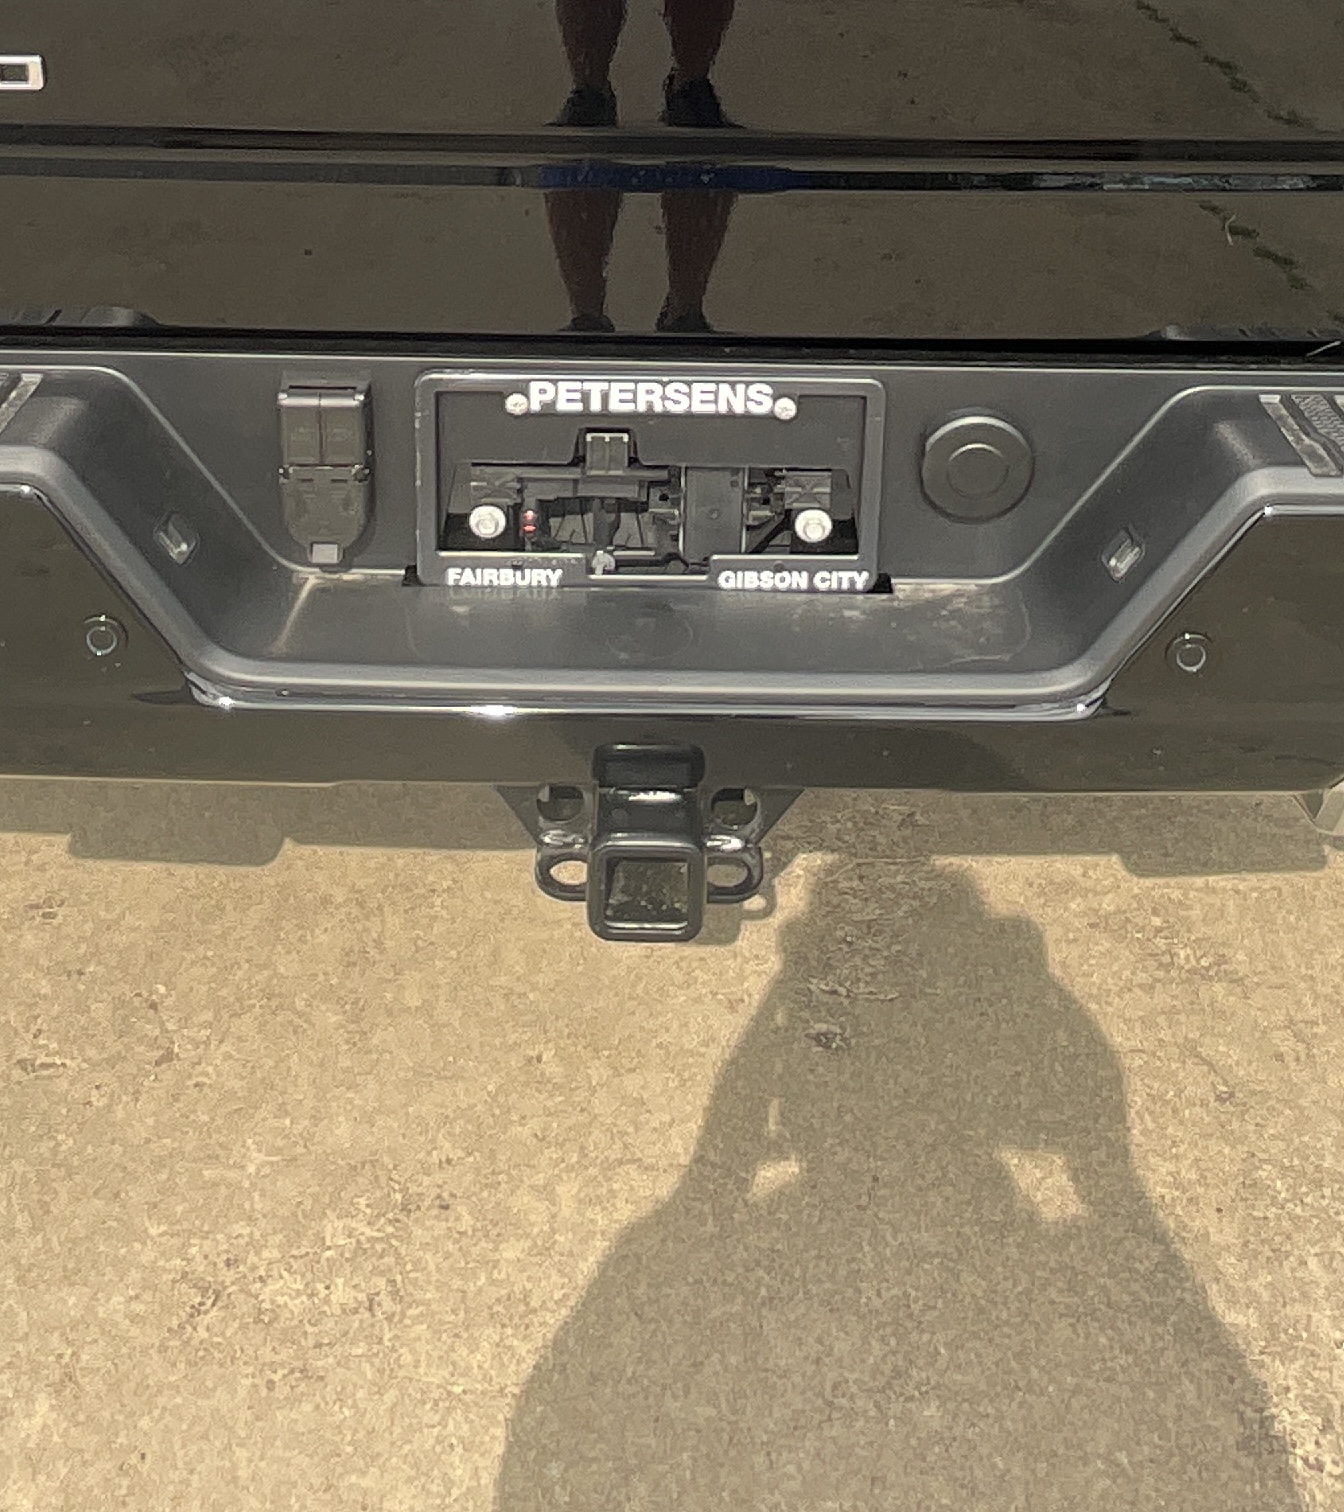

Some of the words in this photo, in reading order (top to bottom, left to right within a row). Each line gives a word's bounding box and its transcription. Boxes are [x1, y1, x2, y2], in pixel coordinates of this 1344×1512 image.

[527, 380, 775, 414] PETERSENS
[446, 567, 563, 587] FAIRBURY
[718, 570, 808, 590] GIBSON
[814, 570, 870, 591] CITY
